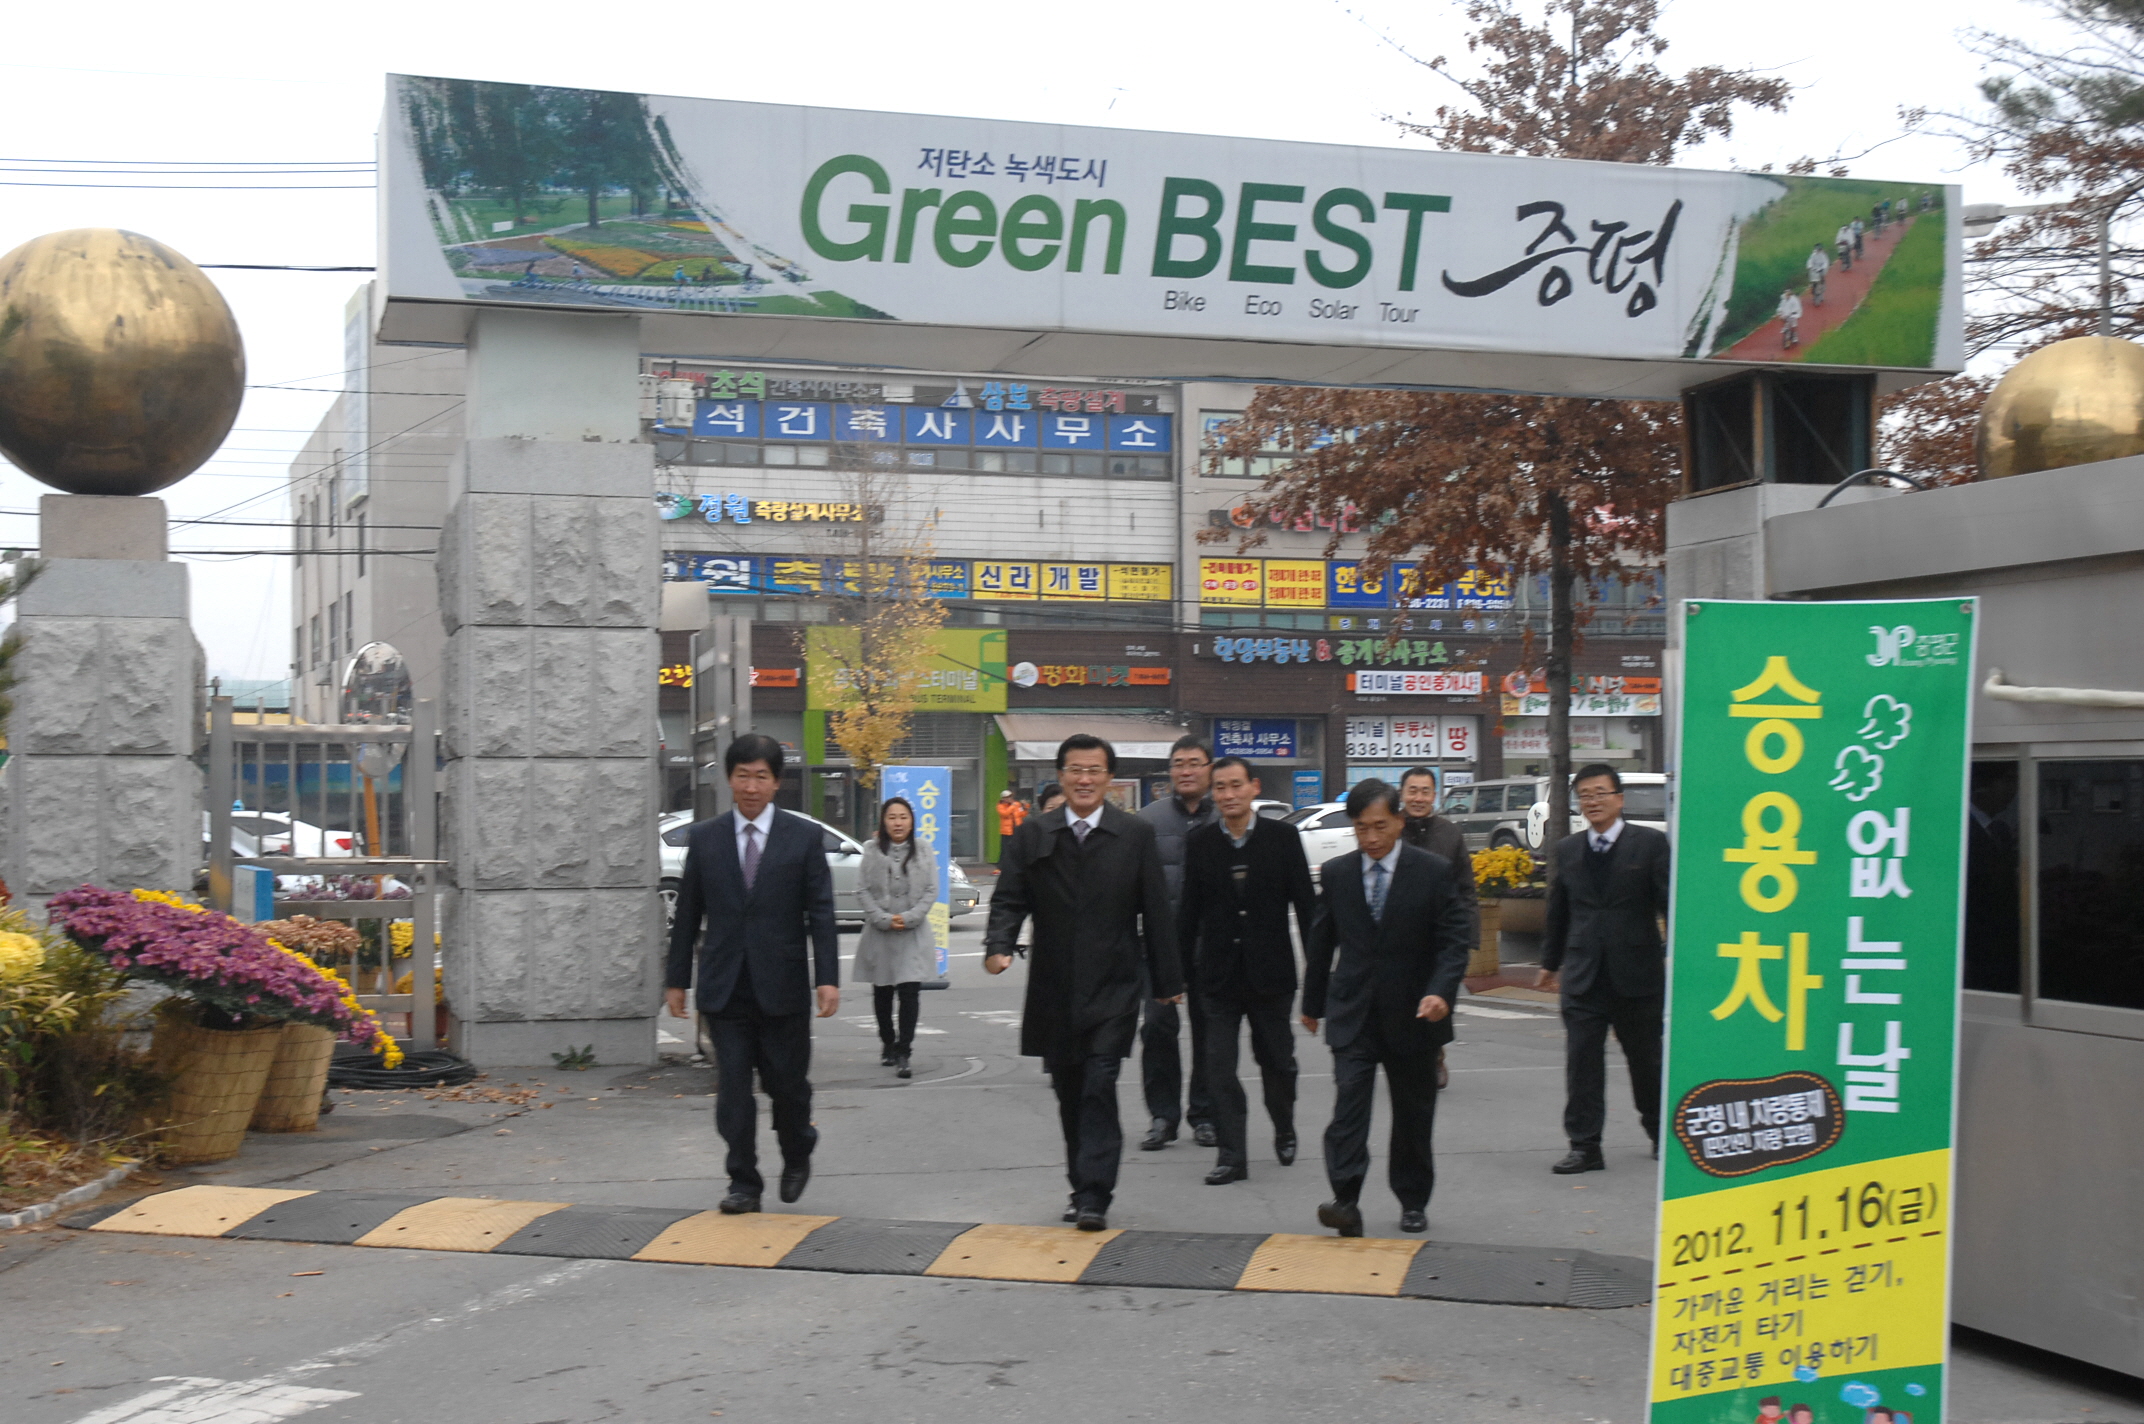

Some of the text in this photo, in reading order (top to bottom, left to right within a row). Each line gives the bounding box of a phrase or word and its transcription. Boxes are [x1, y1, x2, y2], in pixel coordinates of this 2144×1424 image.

[918, 147, 1108, 188] 저탄소 녹색도시
[800, 154, 1452, 292] Green BEST
[1442, 199, 1683, 318] 증평
[1164, 290, 1420, 324] Bike Eco Solar Tour
[710, 370, 766, 401] 초석
[979, 381, 1032, 411] 삼보
[1038, 387, 1126, 413] 측량설계
[651, 404, 1157, 447] 석건축사사무소
[698, 493, 752, 524] 정원
[755, 500, 864, 522] 측량설계사무소
[1213, 636, 1311, 664] 한양부동산
[1315, 638, 1333, 661] &
[1042, 665, 1130, 687] 평화마켓
[931, 694, 977, 704] TERMINAL
[1218, 732, 1293, 746] 건축사 사무소
[1393, 721, 1435, 738] 부동산
[1448, 726, 1469, 752] 땅
[1709, 655, 1824, 1051] 승용차
[1836, 806, 1913, 1113] 없는 날
[1672, 1222, 1754, 1267] 2012.
[1674, 1259, 1904, 1321] 가까운 거리는 걷기,
[1672, 1308, 1804, 1356] 자전거 타기
[1670, 1332, 1879, 1391] 대중교통 이용하기
